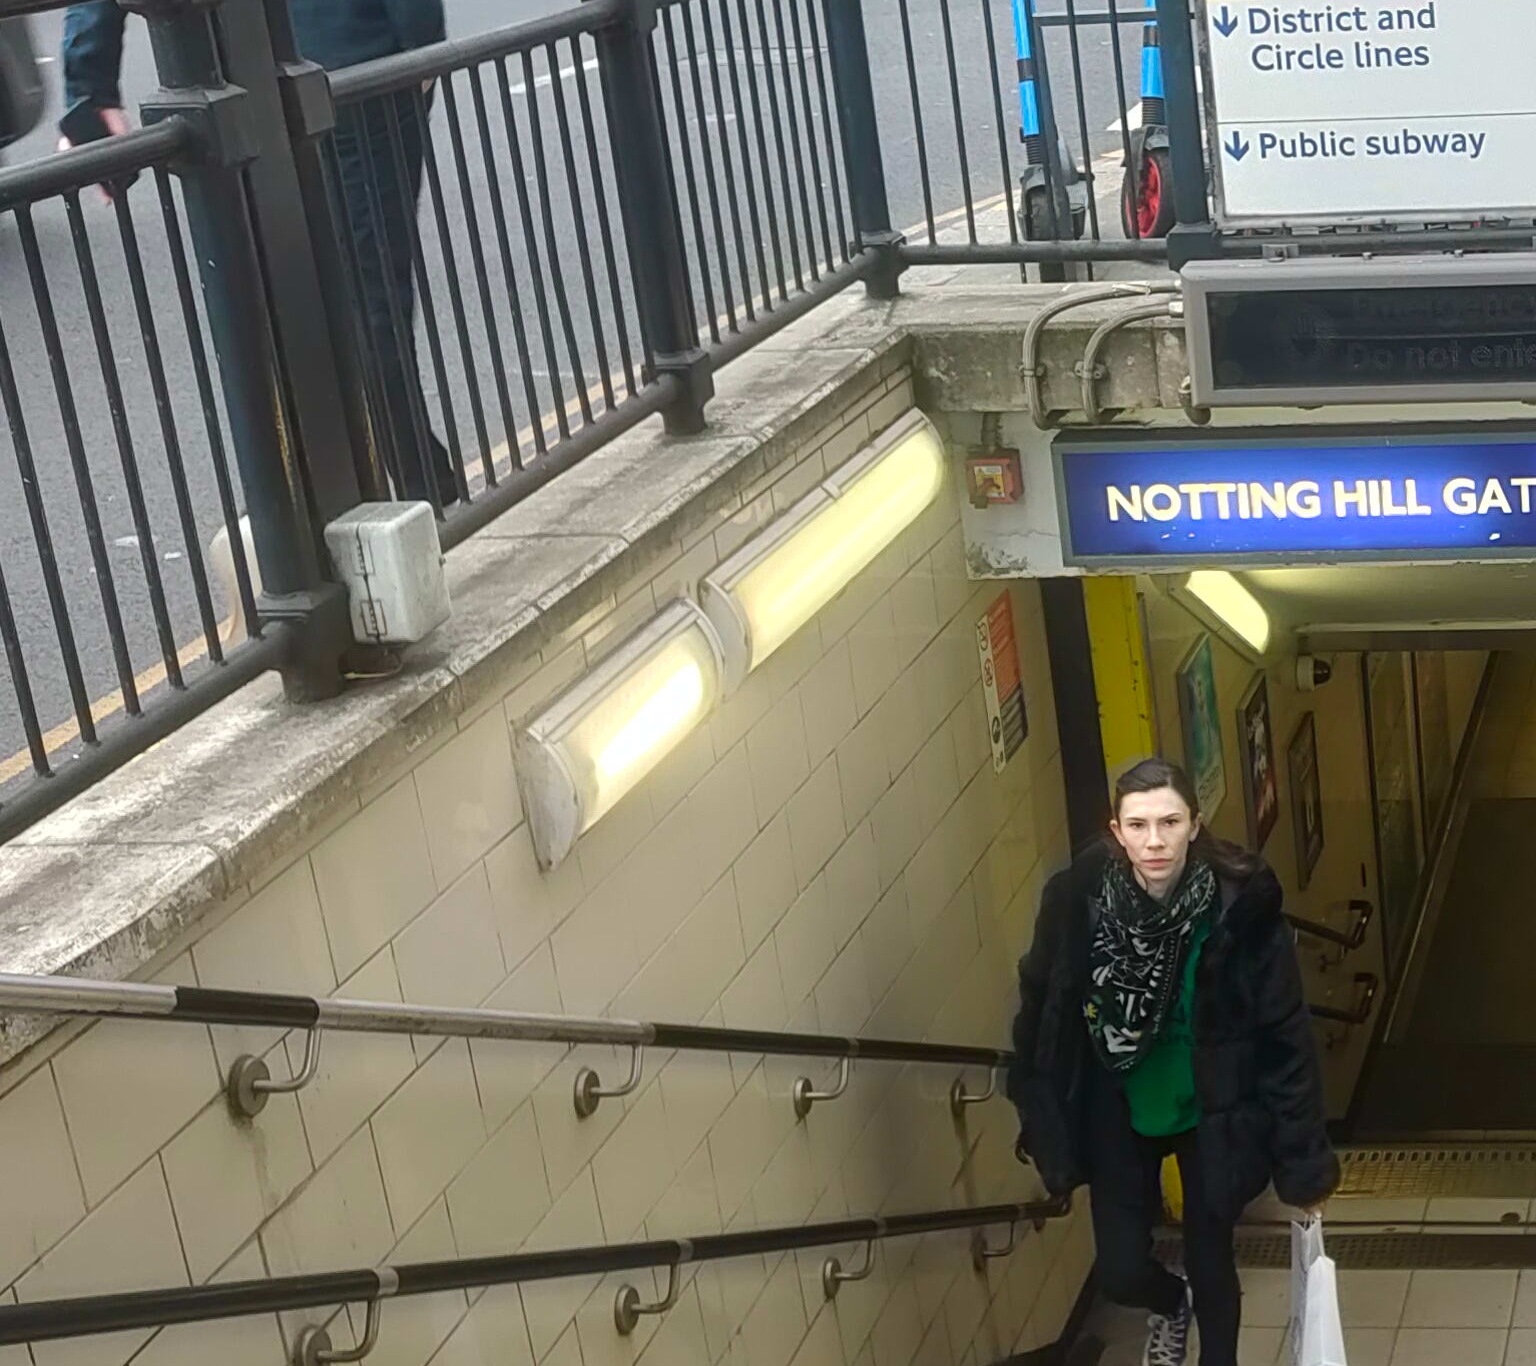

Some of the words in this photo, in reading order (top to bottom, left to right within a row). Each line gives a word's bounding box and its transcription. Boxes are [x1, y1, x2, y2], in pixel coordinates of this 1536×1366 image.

[1247, 4, 1368, 35] District
[1378, 1, 1437, 31] and
[1251, 41, 1344, 72] Circle
[1354, 41, 1431, 69] lines
[1259, 129, 1356, 159] Public
[1365, 127, 1486, 160] subway
[1405, 341, 1462, 370] not
[1105, 478, 1321, 524] NOTTING
[1333, 477, 1432, 519] HILL
